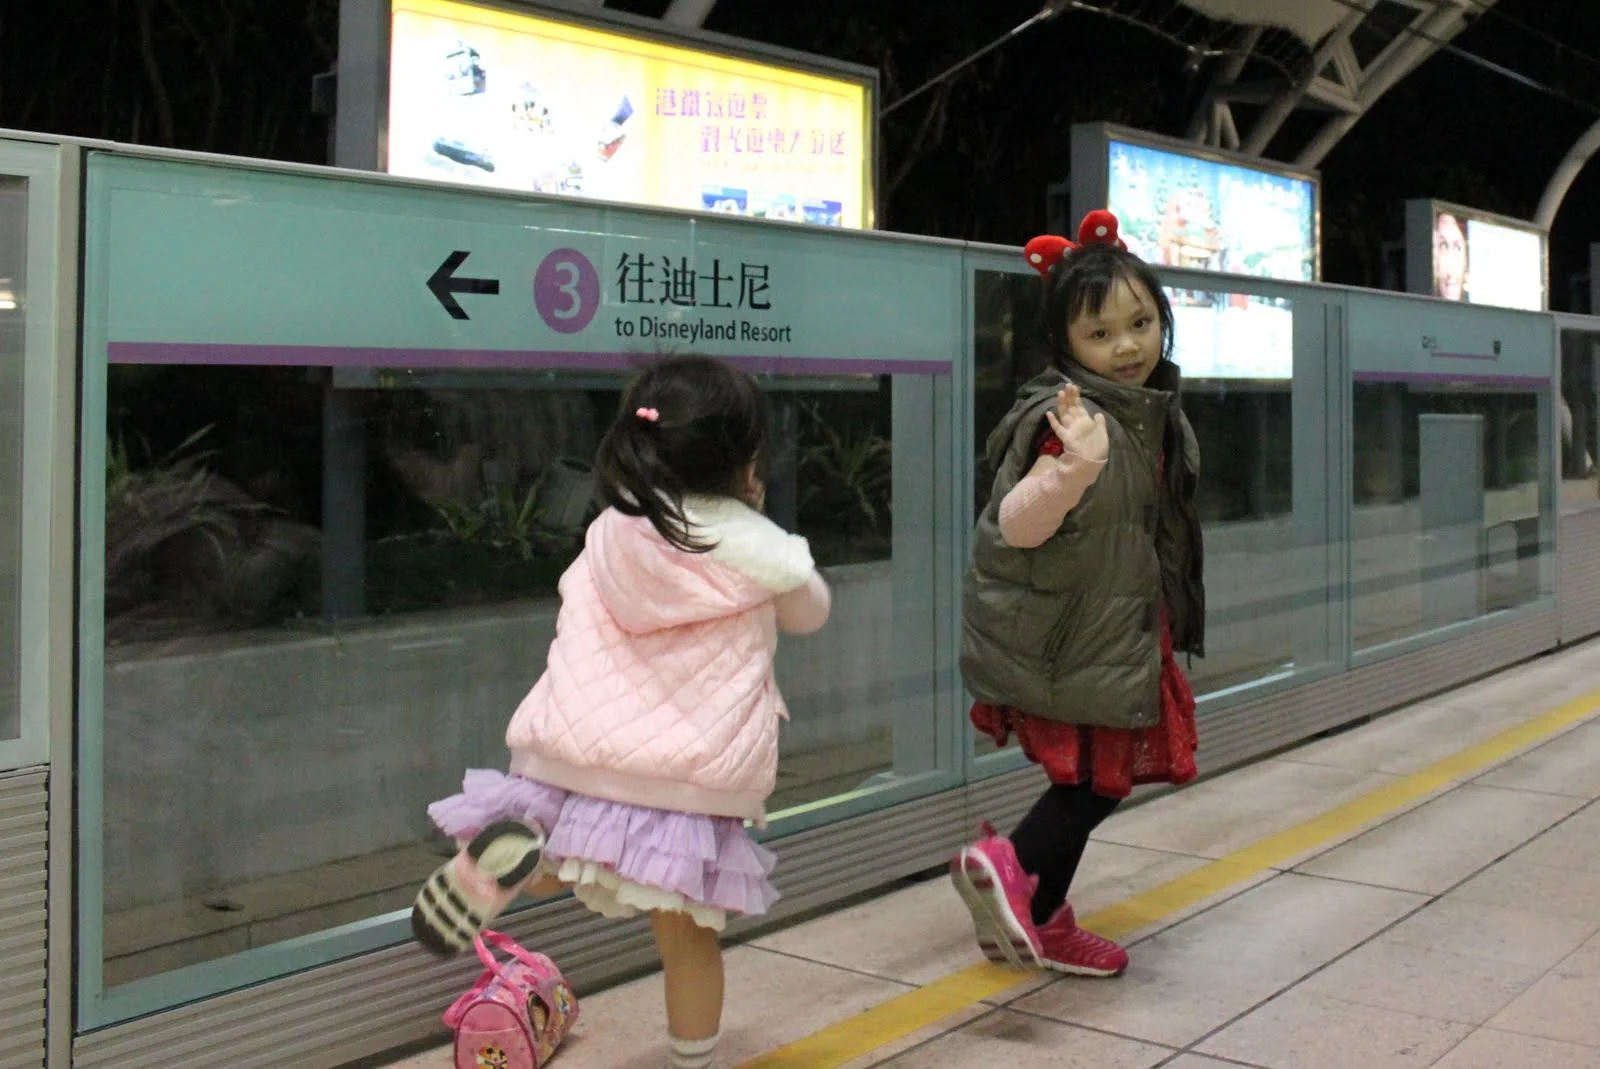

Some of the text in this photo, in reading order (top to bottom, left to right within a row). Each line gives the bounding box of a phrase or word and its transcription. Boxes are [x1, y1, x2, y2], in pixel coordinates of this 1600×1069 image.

[553, 261, 582, 320] 3
[615, 251, 772, 311] 往迪士尼
[615, 316, 792, 344] to Disneyland Resort
